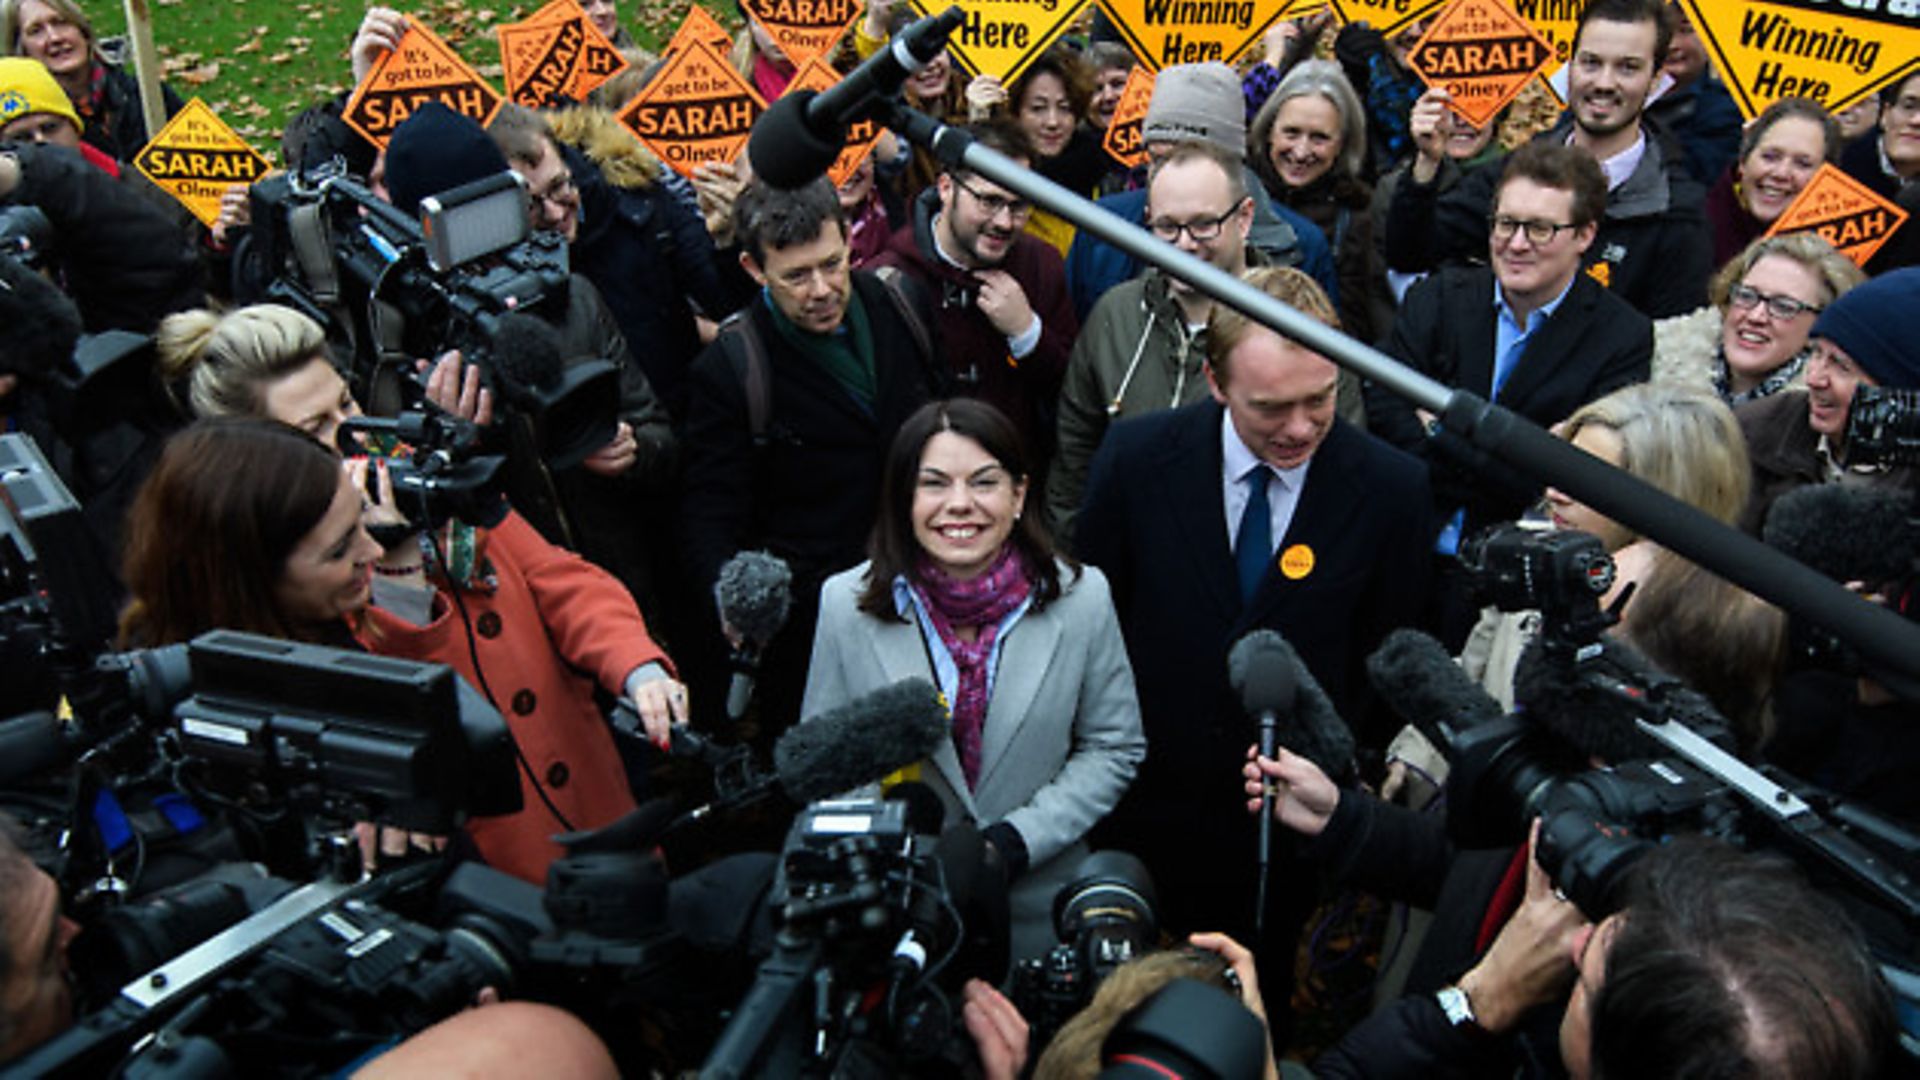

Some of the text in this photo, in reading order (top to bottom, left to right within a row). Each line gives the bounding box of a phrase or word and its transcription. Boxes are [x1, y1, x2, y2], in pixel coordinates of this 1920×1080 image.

[759, 0, 848, 23] SARAH
[1144, 0, 1256, 29] Winning
[1465, 5, 1487, 18] It's
[778, 29, 829, 48] Olney
[962, 11, 1029, 48] Here
[1473, 22, 1488, 32] to
[1163, 32, 1223, 64] Here
[1740, 8, 1881, 75] Winning
[404, 48, 429, 63] It's
[519, 24, 581, 110] SARAH
[1424, 41, 1536, 74] SARAH
[385, 63, 453, 86] got to be
[686, 62, 708, 77] It's
[664, 77, 729, 96] got to be
[1446, 81, 1507, 98] Olney
[1753, 61, 1831, 103] Here
[638, 102, 752, 136] SARAH
[149, 151, 256, 177] SARAH
[667, 144, 728, 162] Olney
[177, 181, 223, 197] Olne
[1817, 211, 1886, 247] RAH
